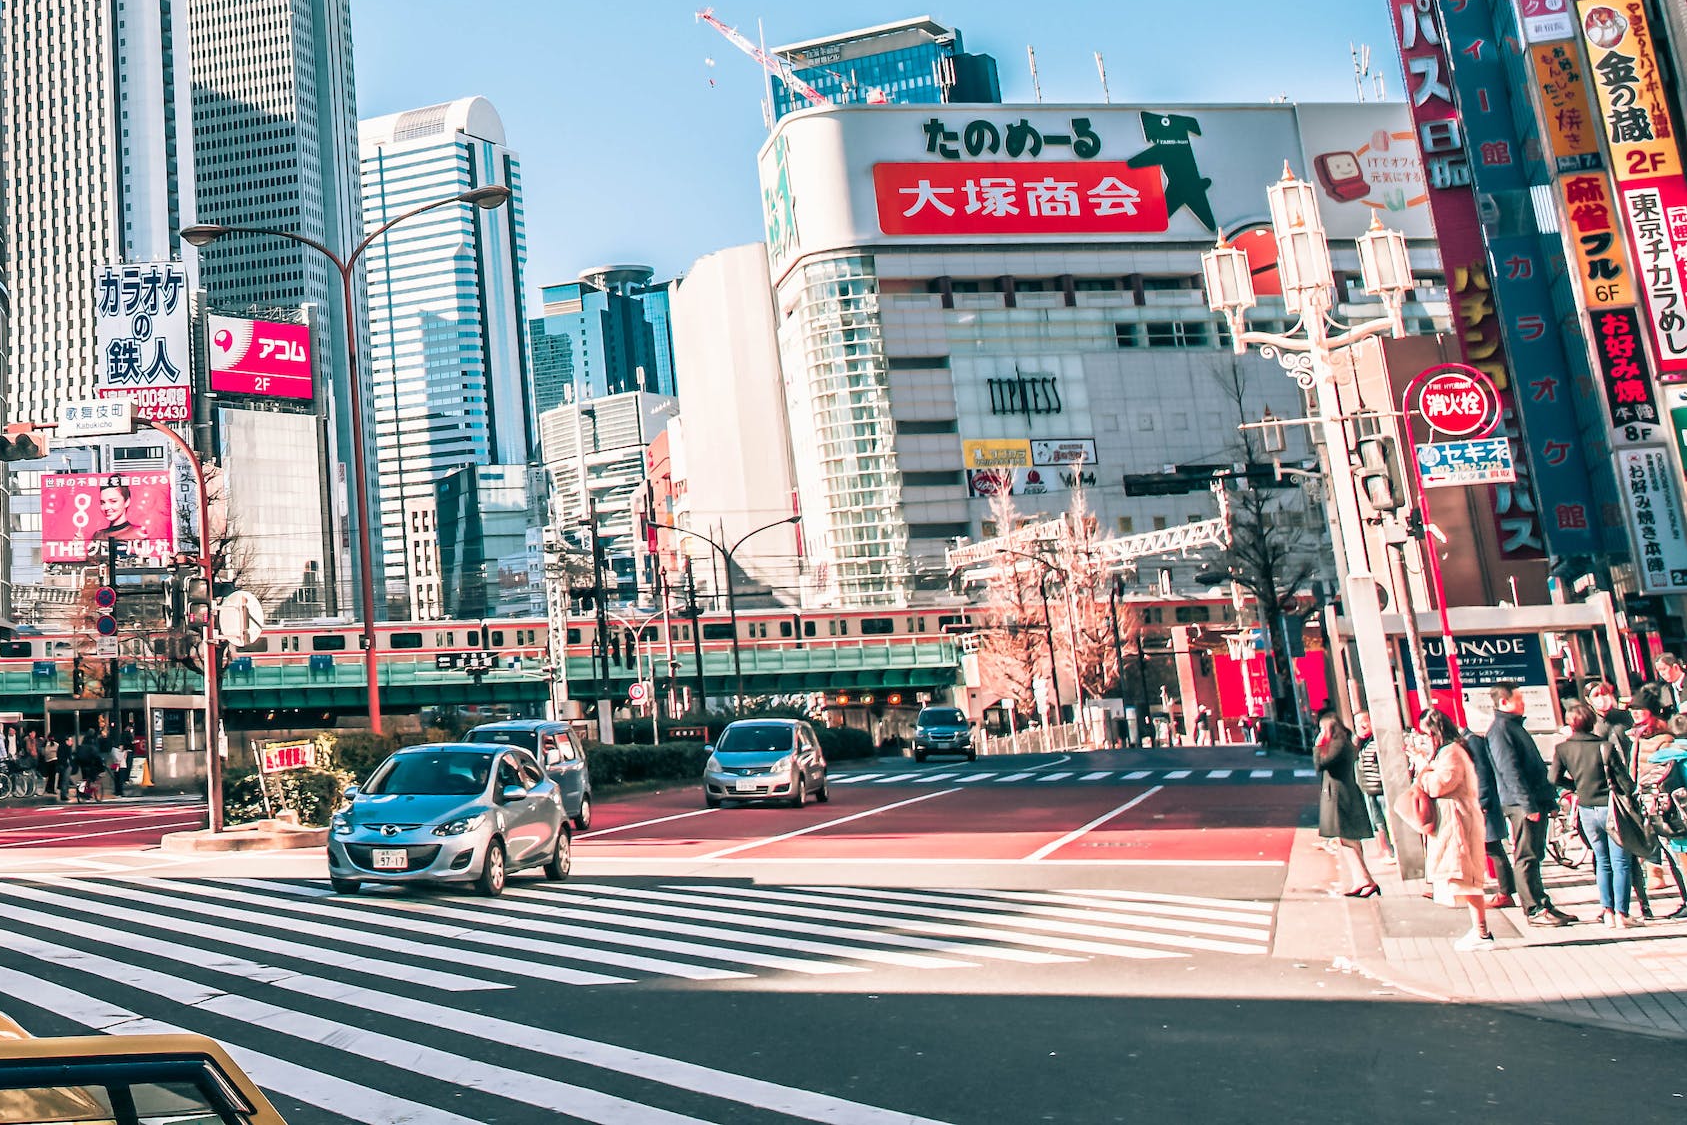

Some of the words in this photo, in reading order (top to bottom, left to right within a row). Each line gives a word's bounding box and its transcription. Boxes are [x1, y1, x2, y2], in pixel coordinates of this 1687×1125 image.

[923, 117, 1102, 160] たのめーる
[1555, 108, 1586, 151] 焼き
[1625, 150, 1667, 175] 2F
[899, 175, 1142, 219] 大塚商会
[1628, 192, 1687, 355] 東京チカラめし
[98, 265, 185, 317] カラオケ
[1595, 283, 1620, 303] 6F
[131, 312, 151, 341] の
[108, 337, 180, 385] 鉄人
[258, 337, 307, 363] アコム
[1599, 313, 1648, 404] お好み焼
[254, 377, 271, 391] 2F
[1505, 255, 1589, 531] カラオケ館
[65, 402, 124, 421] 歌舞伎町
[1426, 392, 1482, 416] 消火栓
[1614, 403, 1655, 421] 本陣
[75, 421, 113, 431] Kabukicho
[1624, 425, 1653, 442] 8F
[1442, 441, 1510, 466] セキネ
[45, 475, 169, 488] 世界の不動産を面白くする
